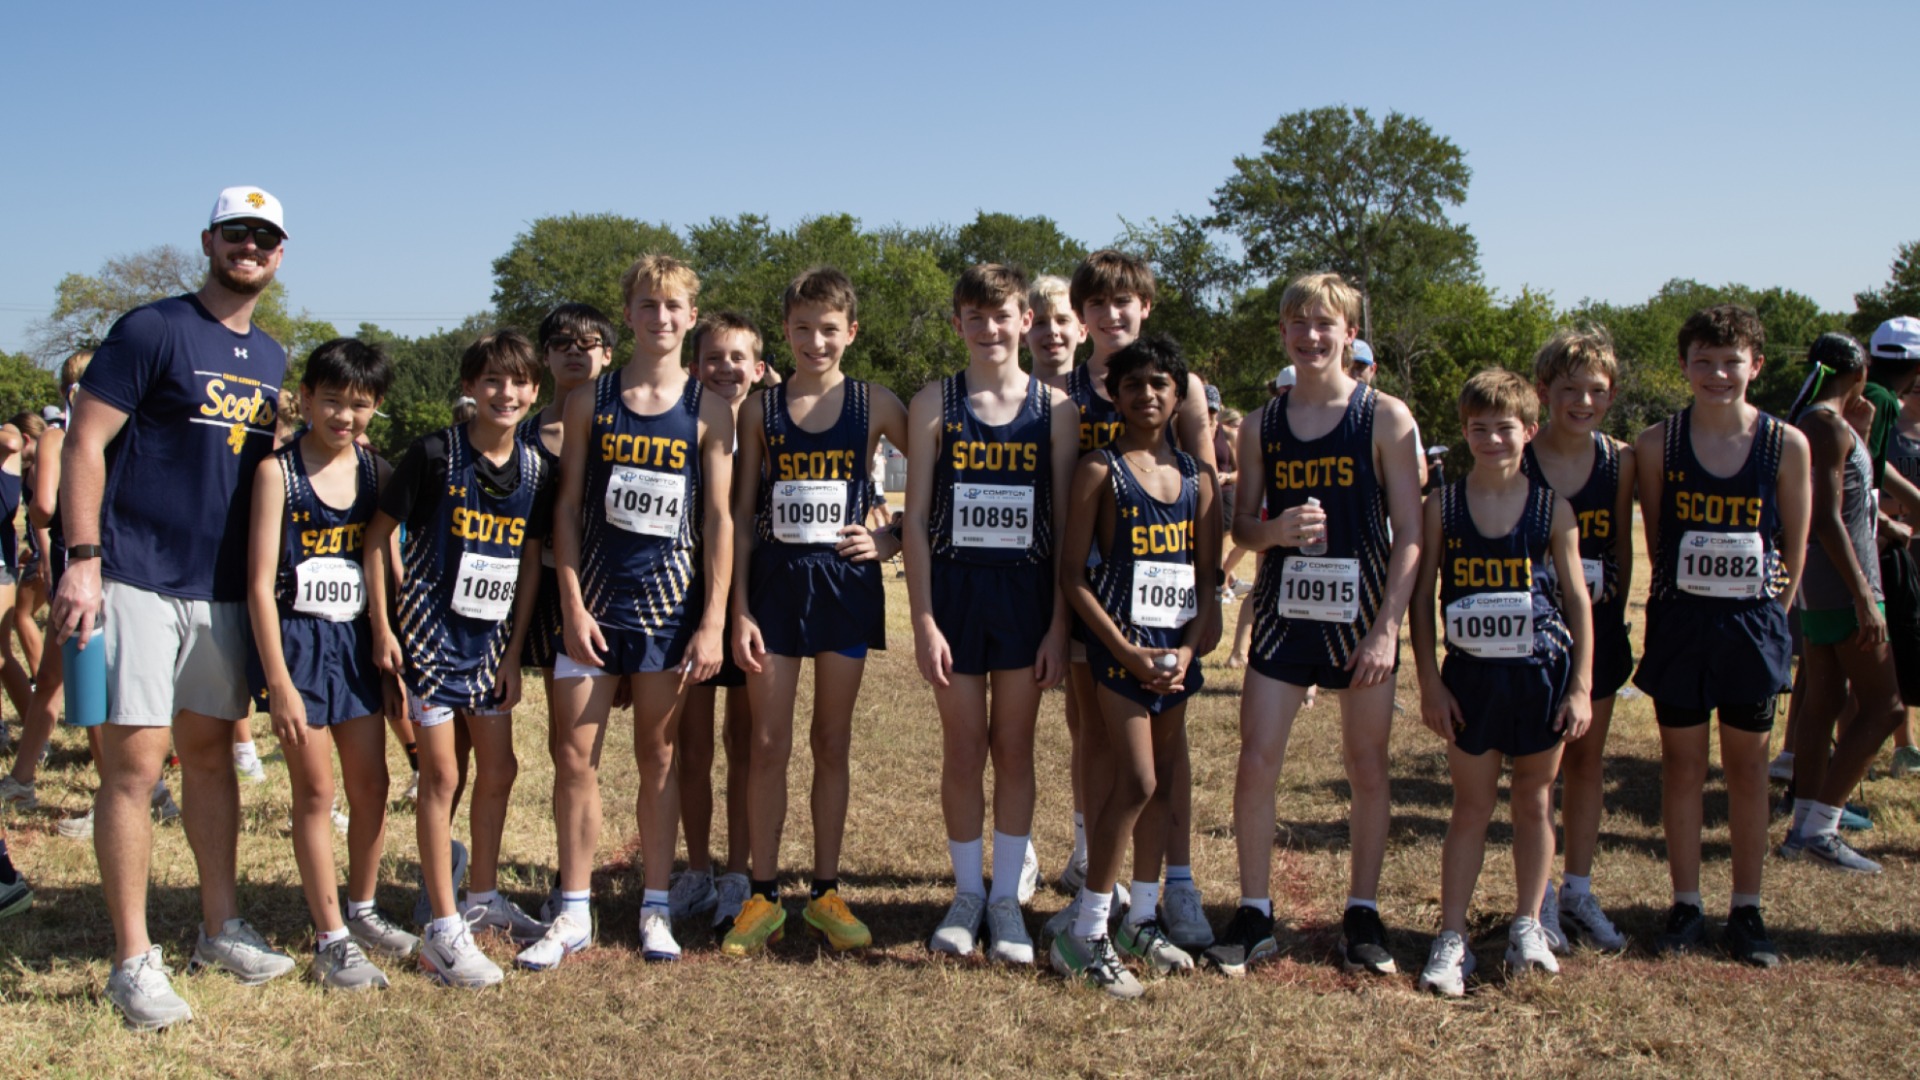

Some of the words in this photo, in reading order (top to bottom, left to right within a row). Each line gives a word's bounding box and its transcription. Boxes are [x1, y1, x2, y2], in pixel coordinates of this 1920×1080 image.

[200, 378, 276, 425] Scots
[602, 433, 688, 469] SCOTS
[953, 441, 1038, 471] SCOTS
[778, 450, 855, 480] SCOTS
[1275, 456, 1355, 489] SCOTS
[612, 487, 678, 518] 10914
[983, 489, 1026, 497] COMPTON
[777, 503, 841, 524] 10909
[959, 505, 1028, 529] 10895
[1676, 491, 1763, 527] SCOTS
[451, 506, 526, 546] SCOTS
[1308, 562, 1351, 570] COMPTON
[1684, 554, 1758, 578] 10882
[304, 580, 361, 603] 10901
[1139, 585, 1195, 609] 10898
[1286, 578, 1354, 603] 10915
[1476, 597, 1522, 605] COMPTON
[1452, 615, 1526, 638] 10907
